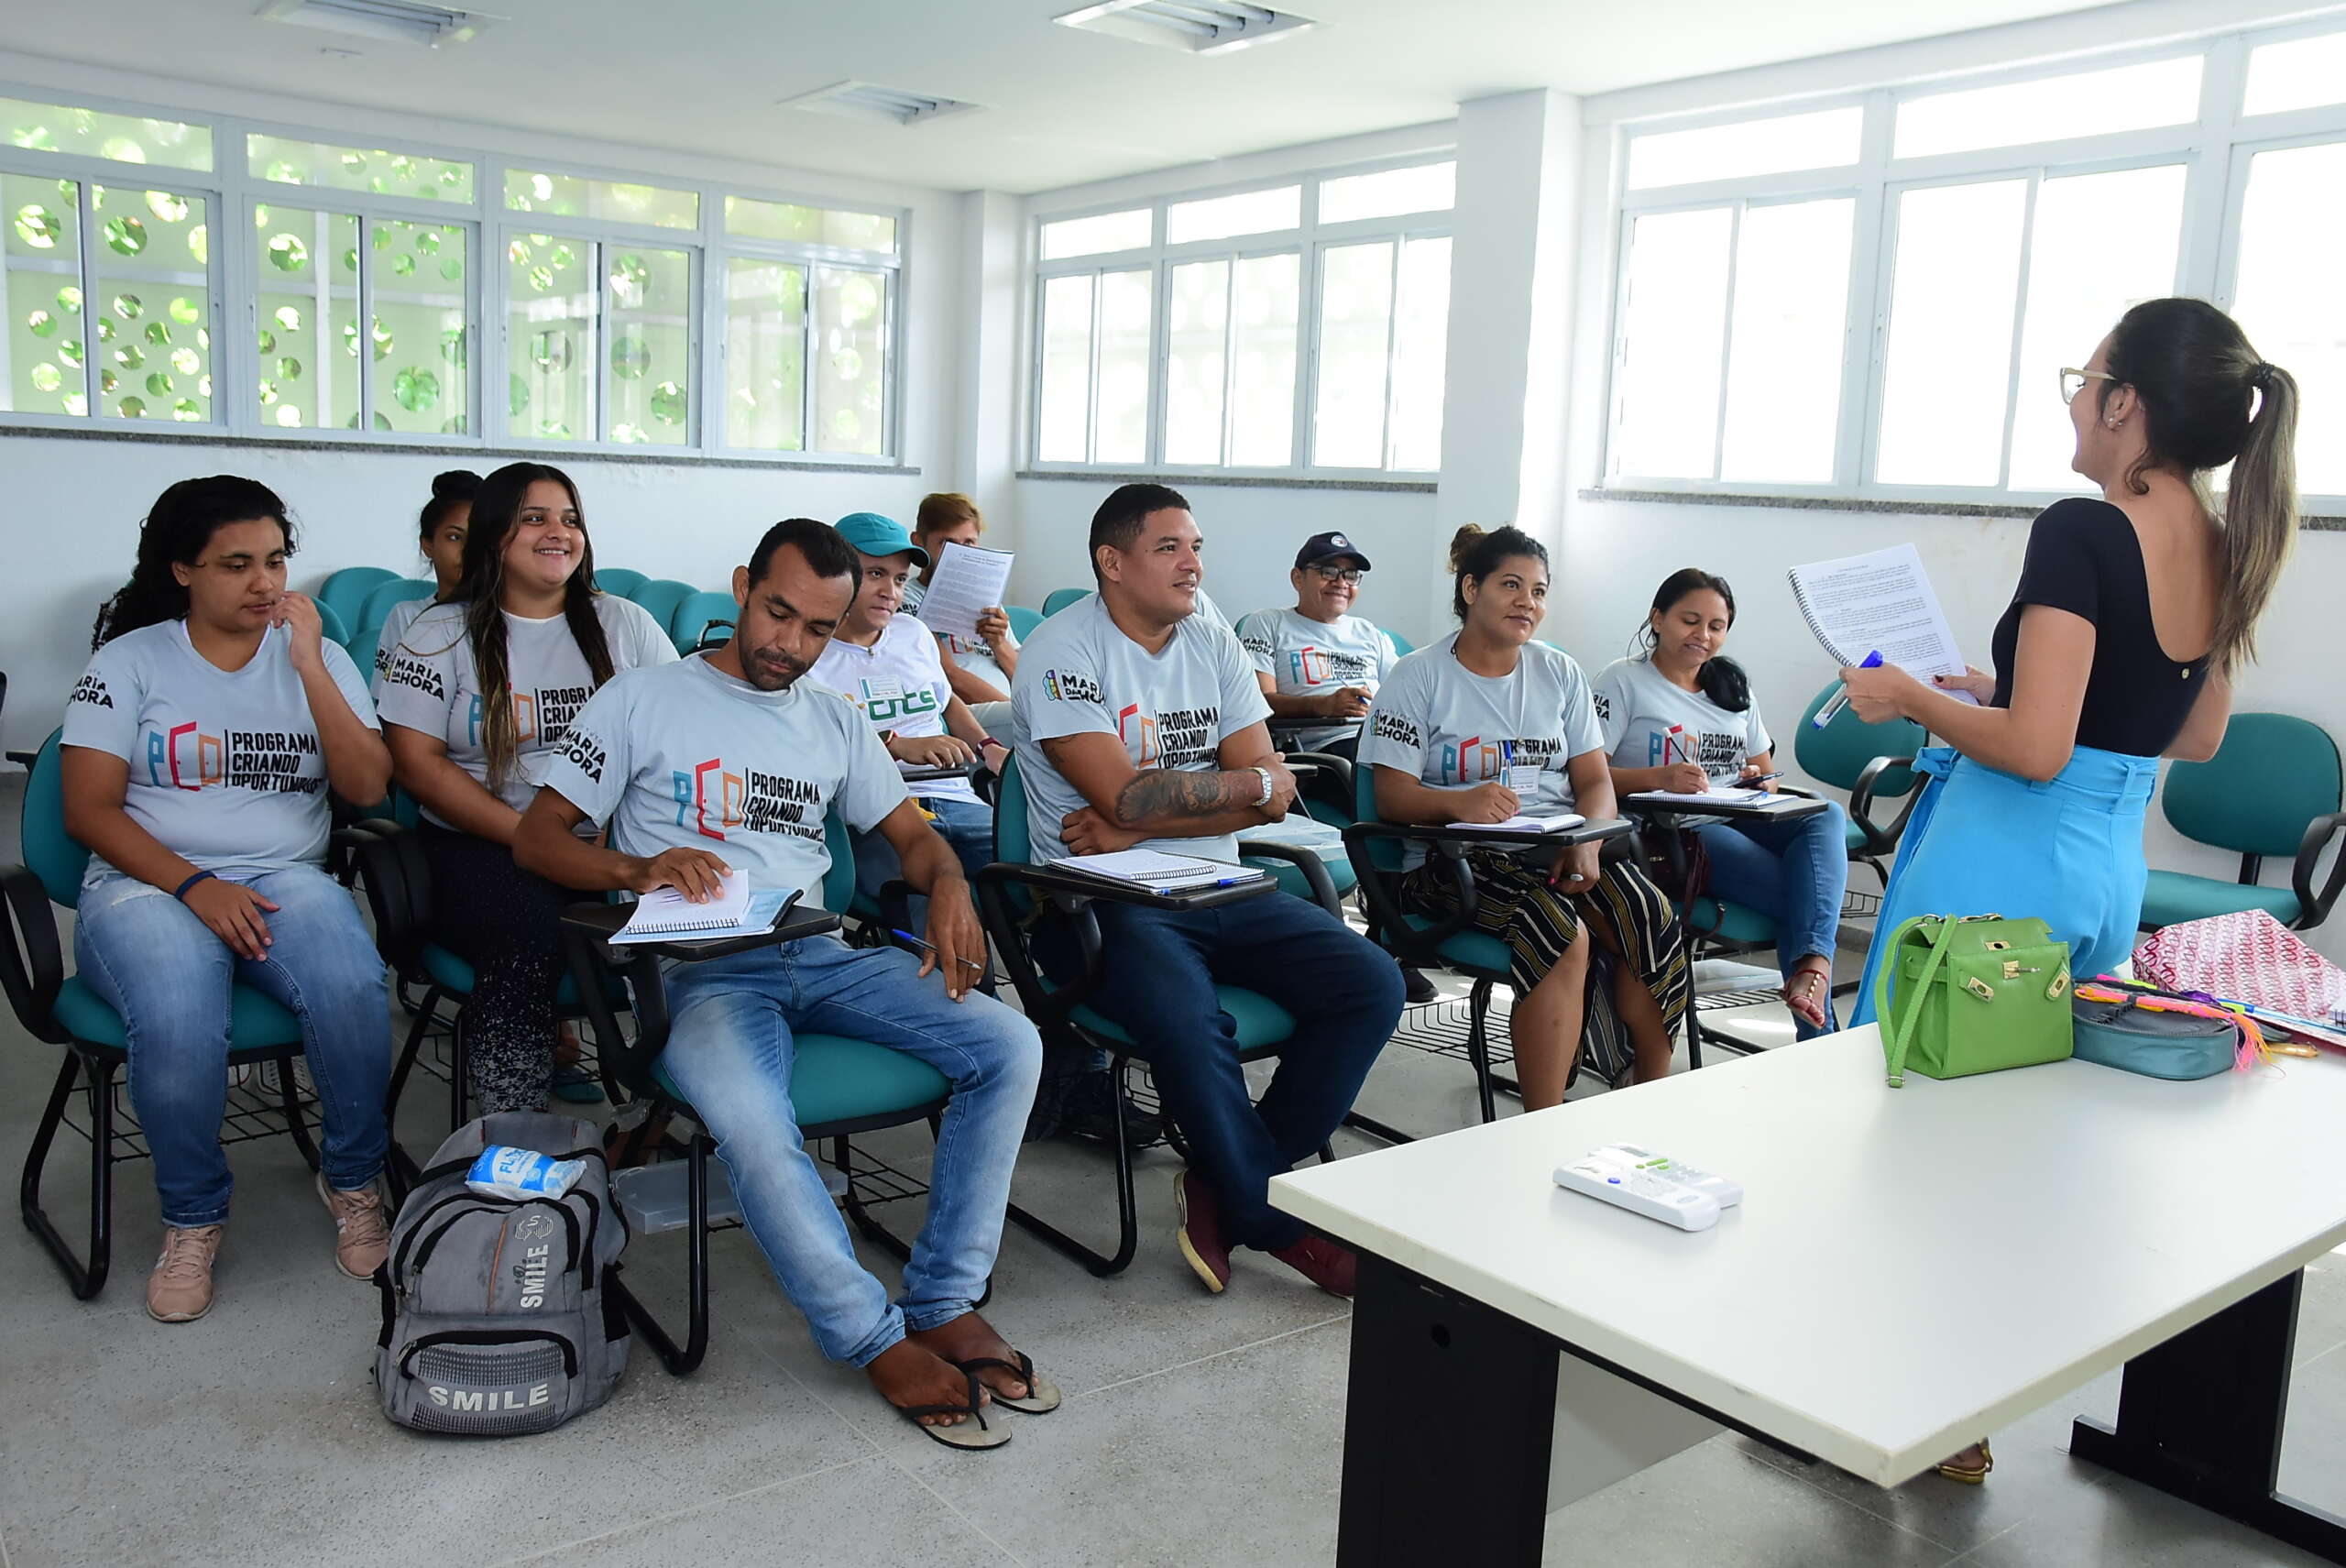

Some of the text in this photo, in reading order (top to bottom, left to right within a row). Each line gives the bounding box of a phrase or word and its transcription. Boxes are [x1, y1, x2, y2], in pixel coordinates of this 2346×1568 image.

[75, 675, 106, 692] ARIA
[395, 658, 444, 686] MARIA
[400, 672, 445, 702] HORA
[541, 685, 596, 707] PROGRA
[1061, 674, 1100, 696] MAR
[1593, 695, 1610, 709] RIA
[543, 705, 582, 724] CRIA
[1158, 707, 1219, 732] PROGRAMA
[1379, 714, 1419, 737] MARIA
[1595, 706, 1610, 722] RA
[231, 732, 318, 756] PROGRAMA
[562, 729, 607, 767] MARIA
[1161, 729, 1208, 751] CRIANDO
[1383, 726, 1420, 750] HORA
[1702, 733, 1746, 751] PROGRAM
[232, 752, 301, 774] CRIANDO
[751, 772, 821, 806] PROGRAMA
[747, 795, 805, 823] CRIANDO
[520, 1244, 549, 1309] SMILE
[429, 1383, 550, 1411] SMILE
